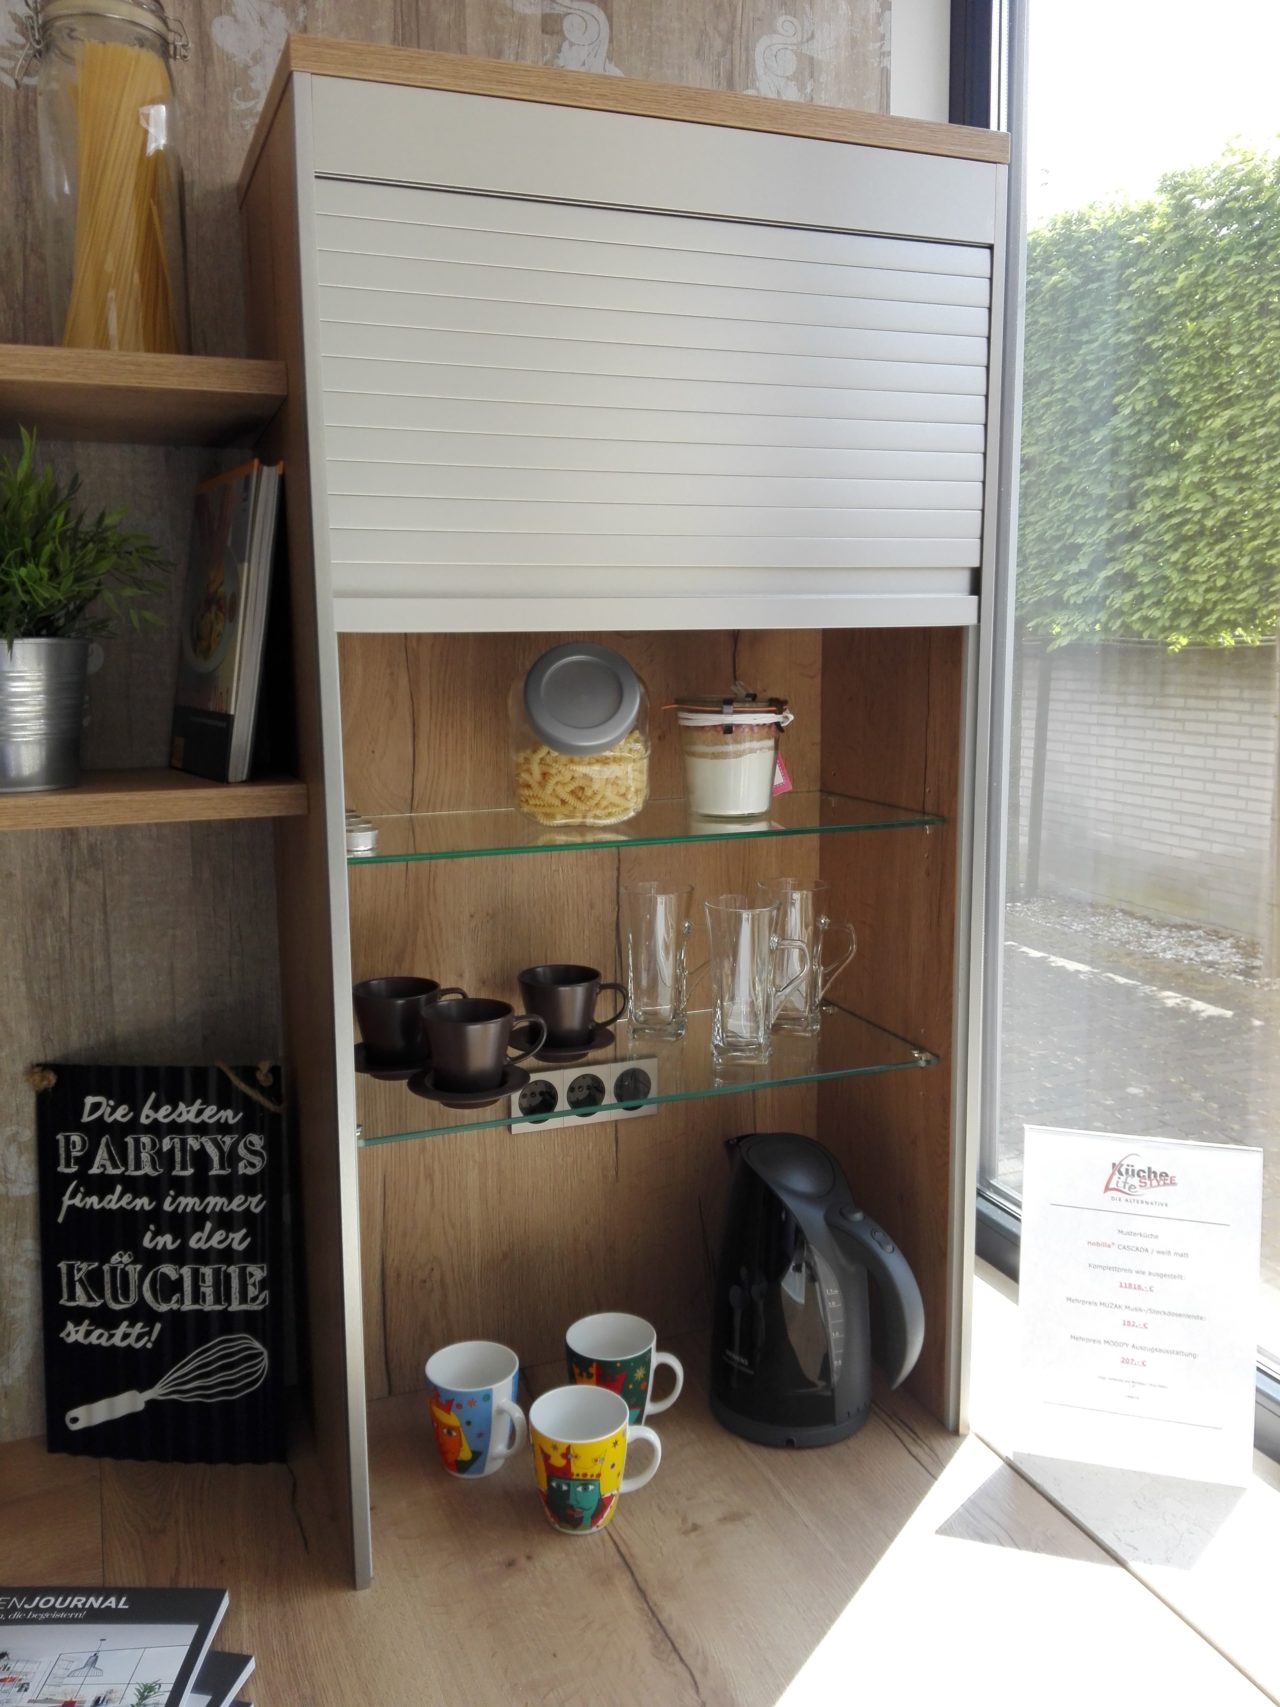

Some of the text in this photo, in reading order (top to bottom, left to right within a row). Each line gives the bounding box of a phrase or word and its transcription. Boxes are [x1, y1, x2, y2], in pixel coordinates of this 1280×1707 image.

[81, 1092, 243, 1125] Die besten
[56, 1132, 267, 1176] PARTYS
[57, 1180, 266, 1223] finden immer
[142, 1221, 250, 1251] in der
[57, 1251, 269, 1312] KÜCHE
[59, 1320, 161, 1349] statt!
